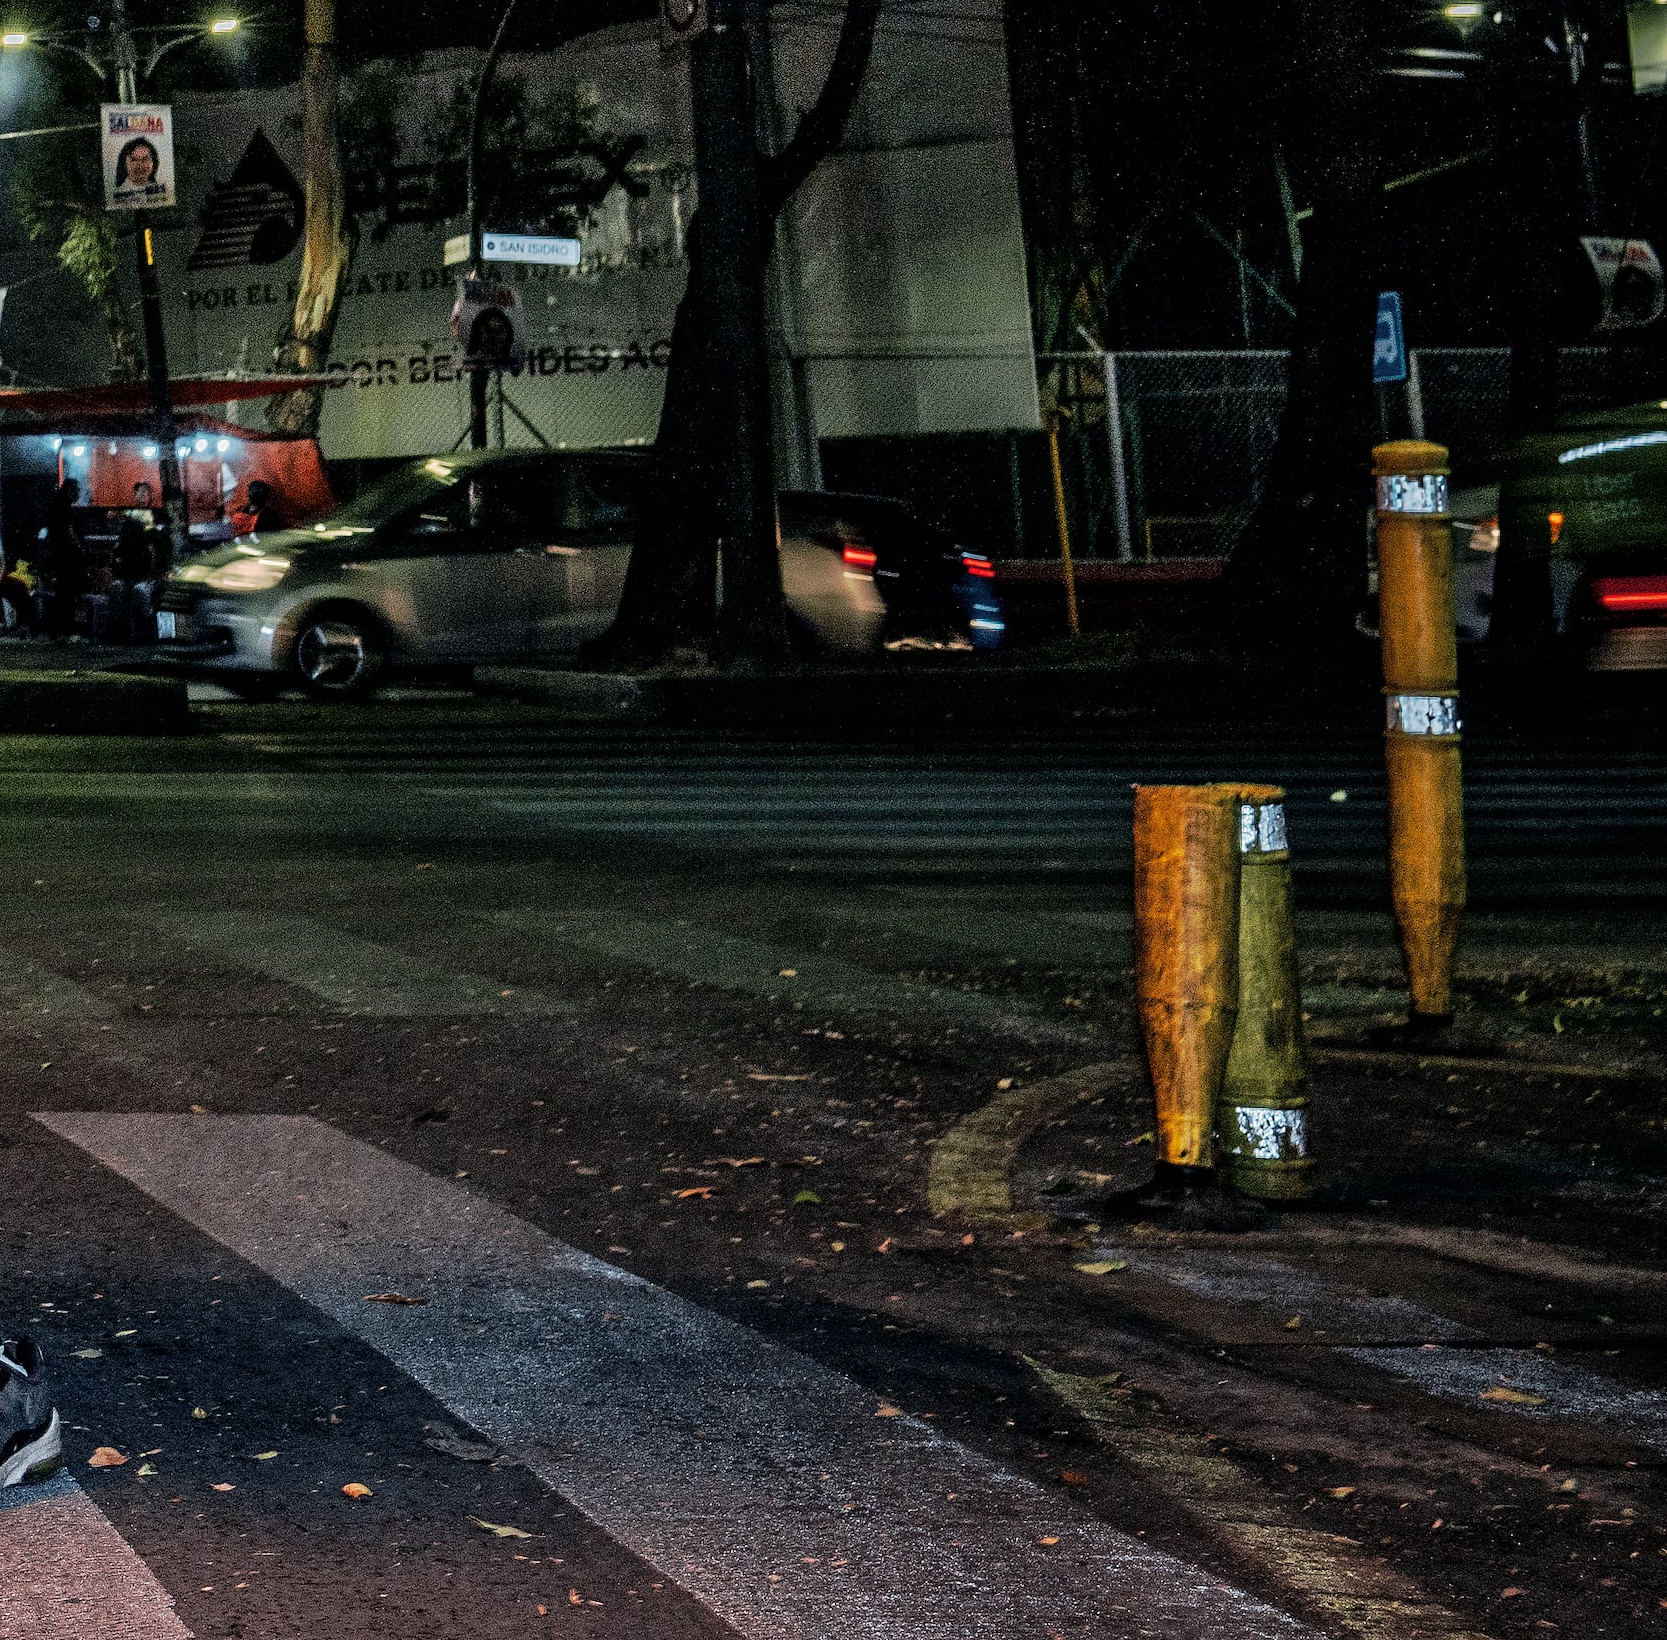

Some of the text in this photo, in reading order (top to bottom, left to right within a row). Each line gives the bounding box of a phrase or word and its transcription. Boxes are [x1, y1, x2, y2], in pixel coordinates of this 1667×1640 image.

[499, 240, 569, 257] SAN ISIDRO
[188, 287, 238, 310] POR
[246, 284, 277, 305] EL
[420, 266, 456, 291] DE
